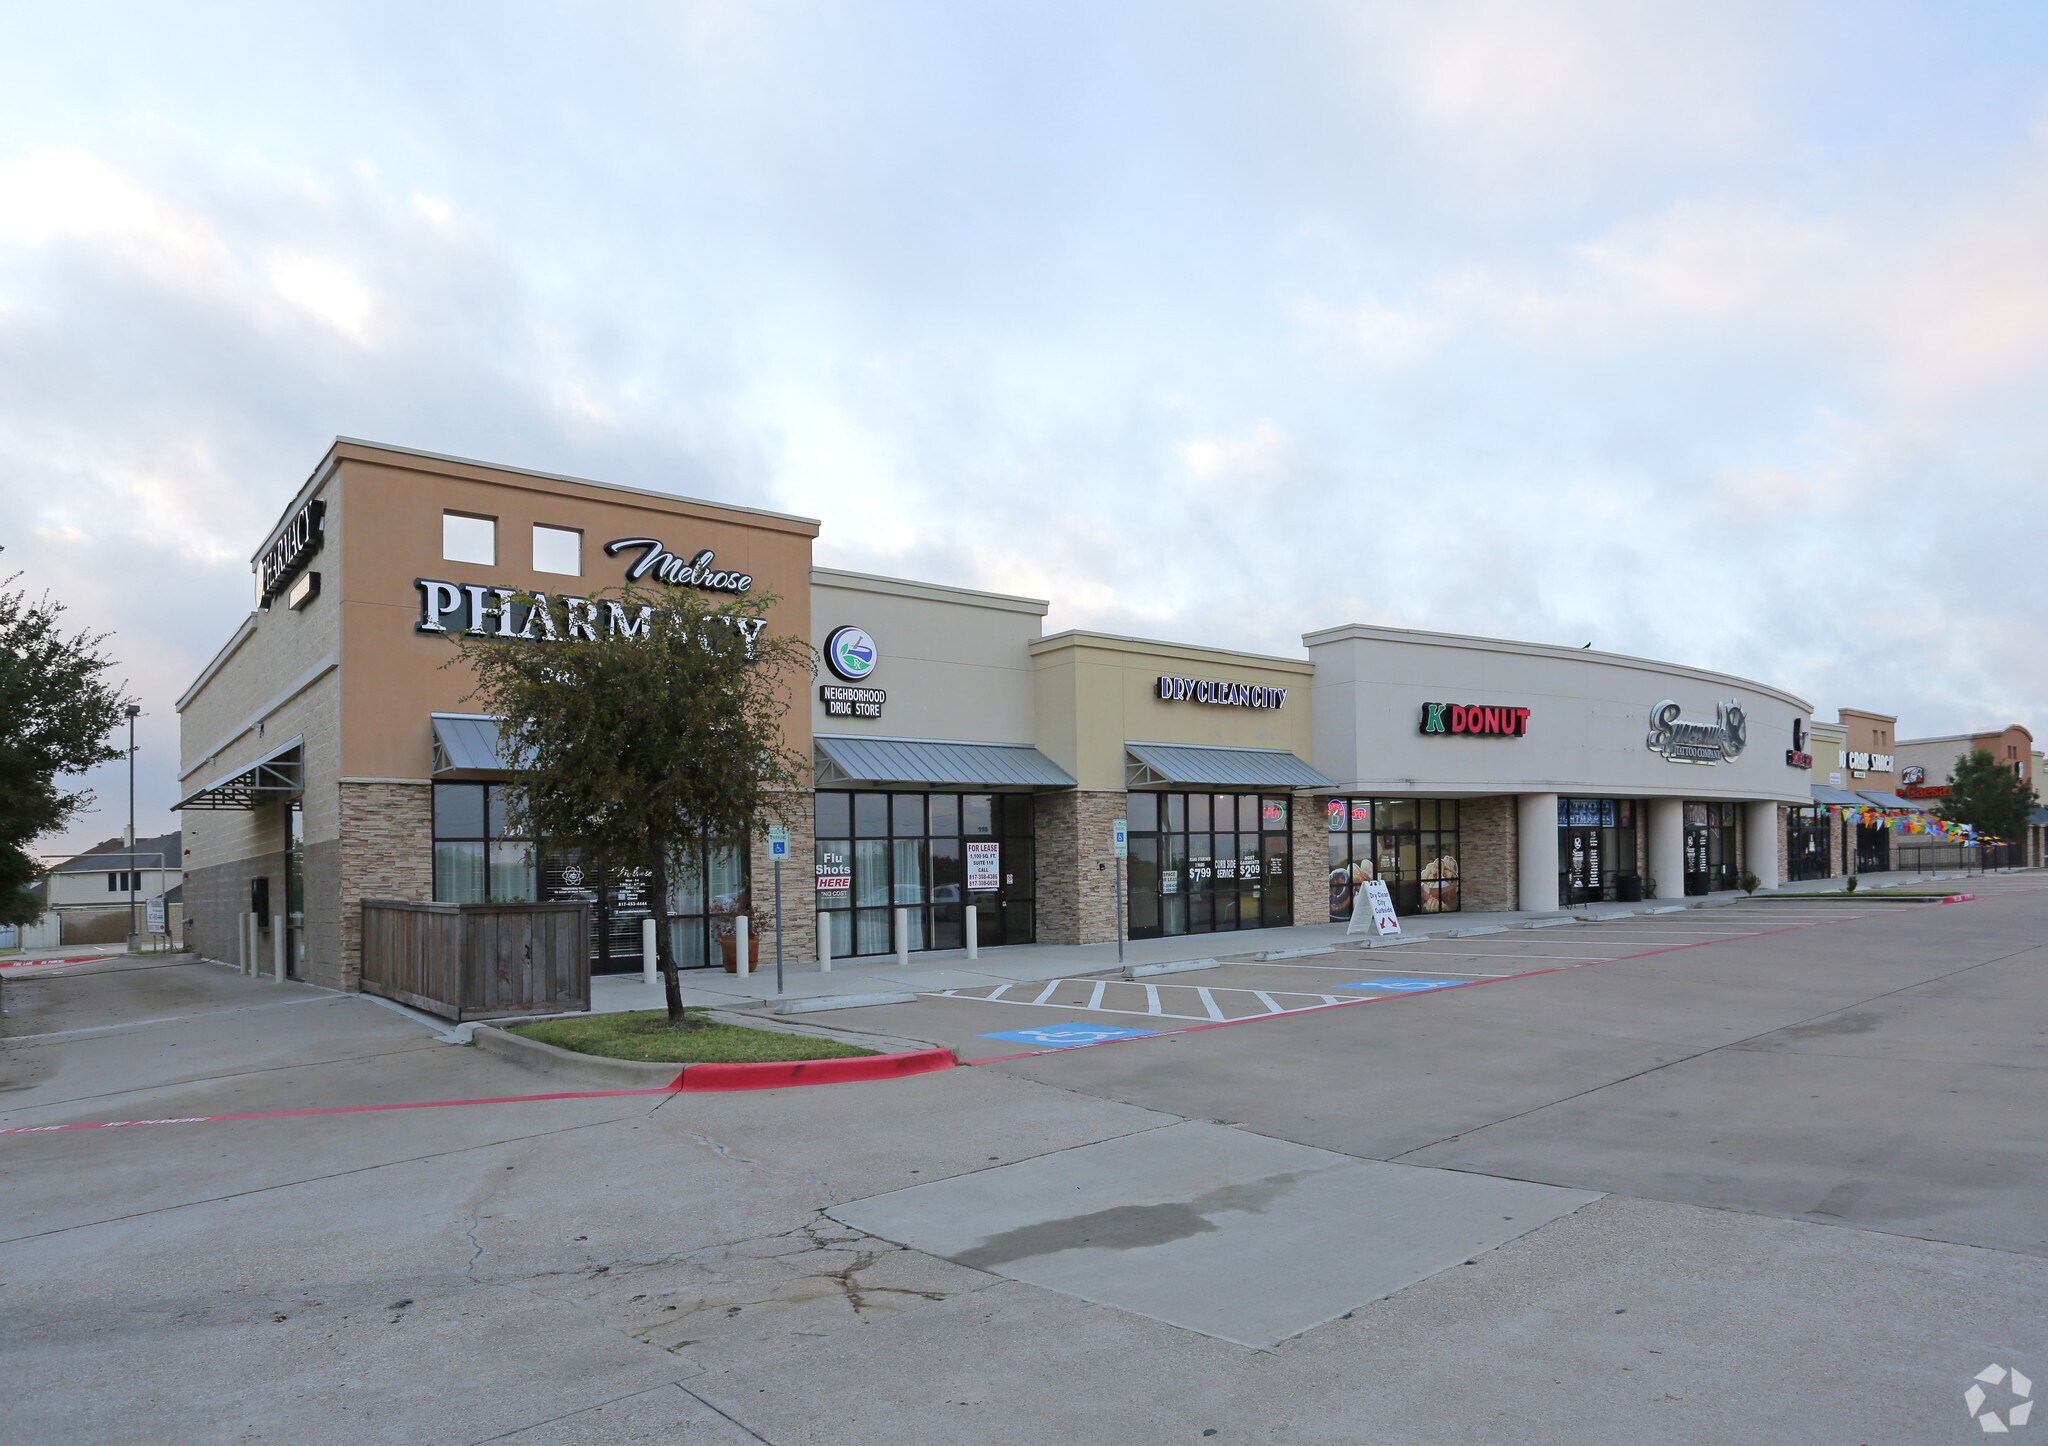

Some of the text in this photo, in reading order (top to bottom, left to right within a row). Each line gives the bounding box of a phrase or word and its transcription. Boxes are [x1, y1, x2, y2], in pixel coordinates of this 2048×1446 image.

[605, 538, 752, 593] Melrose
[824, 686, 885, 703] NEIGHBORHOOD
[1161, 676, 1288, 709] DRY CLEAN CITY
[830, 701, 880, 716] DRUG STORE
[1426, 704, 1530, 734] K DONUT
[1676, 746, 1721, 759] TATTOO COMPANY
[1849, 751, 1870, 770] CRAB
[1871, 753, 1895, 772] SHACK
[1905, 784, 1953, 799] Caesar
[1352, 809, 1367, 818] OPEN
[823, 853, 843, 863] Flu
[1214, 860, 1236, 869] CURB SIDE
[816, 865, 851, 874] Shots
[1216, 869, 1235, 878] SERVICE
[819, 879, 850, 887] HERE
